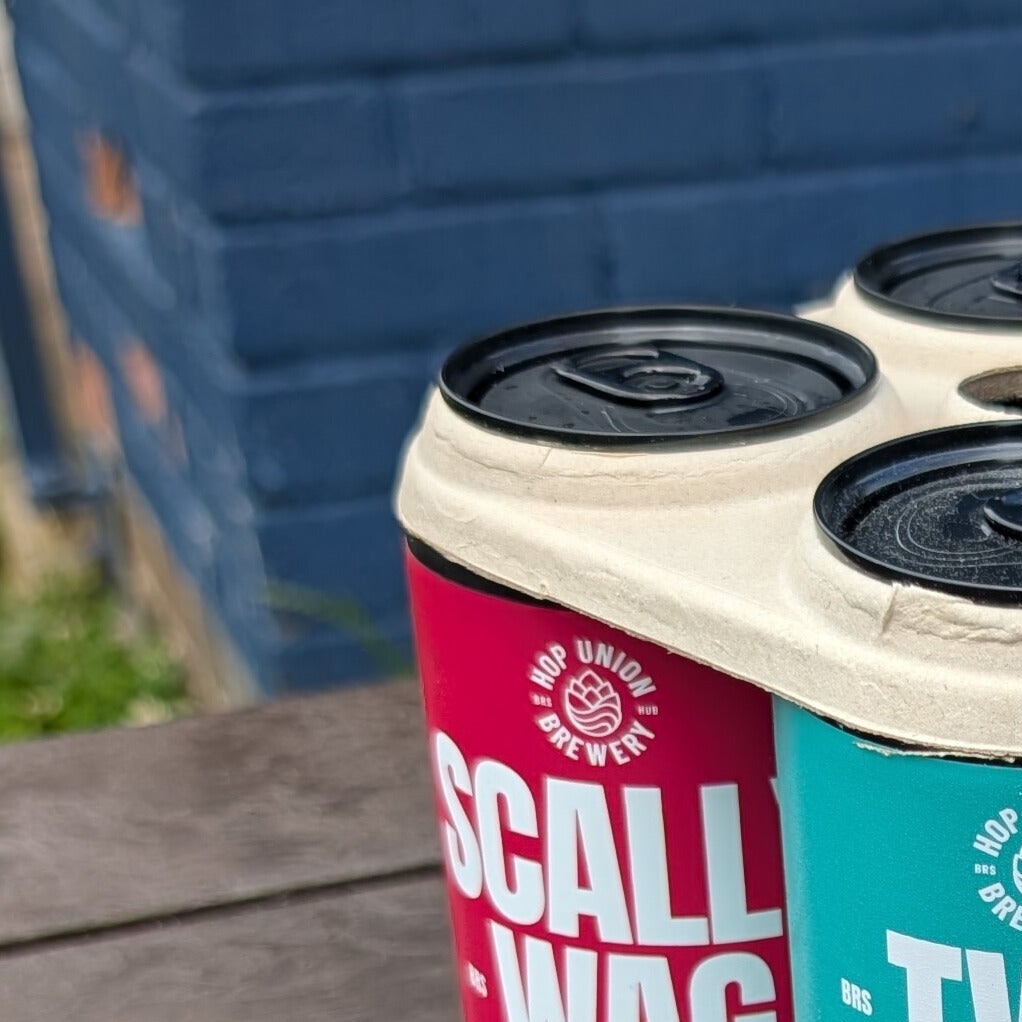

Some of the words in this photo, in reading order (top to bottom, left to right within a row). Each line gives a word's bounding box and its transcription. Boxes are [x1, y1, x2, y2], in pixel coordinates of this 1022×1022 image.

[529, 643, 568, 691] HOP
[575, 638, 657, 698] UNION
[637, 705, 659, 716] HUB
[537, 720, 656, 767] BREWERY
[435, 731, 784, 946] SCALL
[972, 807, 1019, 858] HOP
[974, 863, 997, 876] BRS
[841, 977, 873, 1016] BRS
